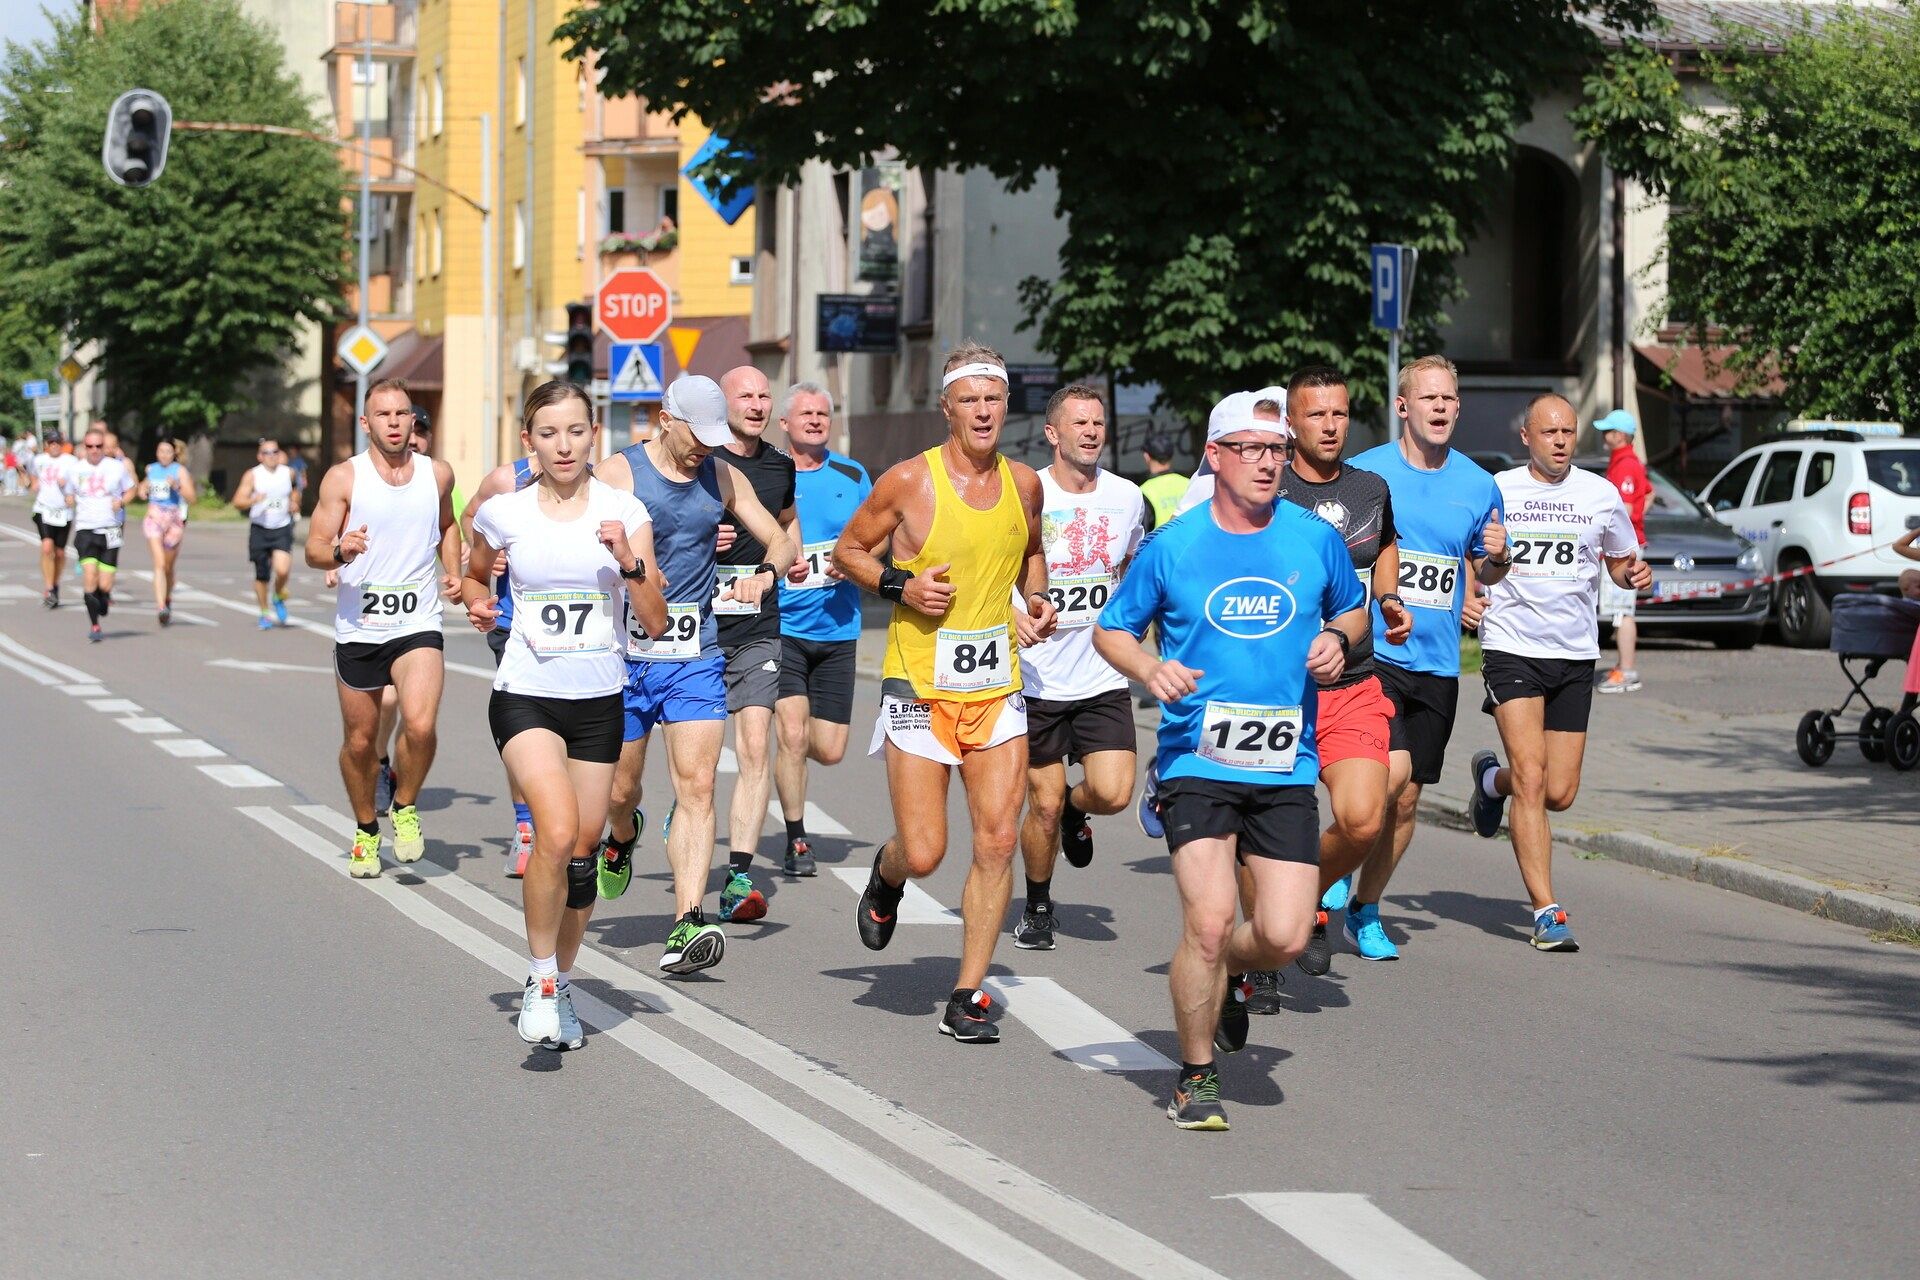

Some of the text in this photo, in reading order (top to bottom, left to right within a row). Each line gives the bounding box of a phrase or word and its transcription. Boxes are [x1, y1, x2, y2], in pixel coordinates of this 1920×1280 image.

[1377, 254, 1394, 319] P
[604, 293, 664, 318] STOP
[1505, 512, 1593, 525] KOSMETYCZNY
[1523, 501, 1575, 512] GABINET
[1512, 540, 1574, 566] 278
[1399, 562, 1455, 594] 286
[362, 592, 418, 616] 290
[1048, 584, 1108, 612] 320
[1221, 595, 1282, 615] ZWAE
[541, 603, 593, 636] 97
[953, 640, 999, 674] 84
[901, 703, 931, 713] BIEG
[1210, 720, 1295, 751] 126
